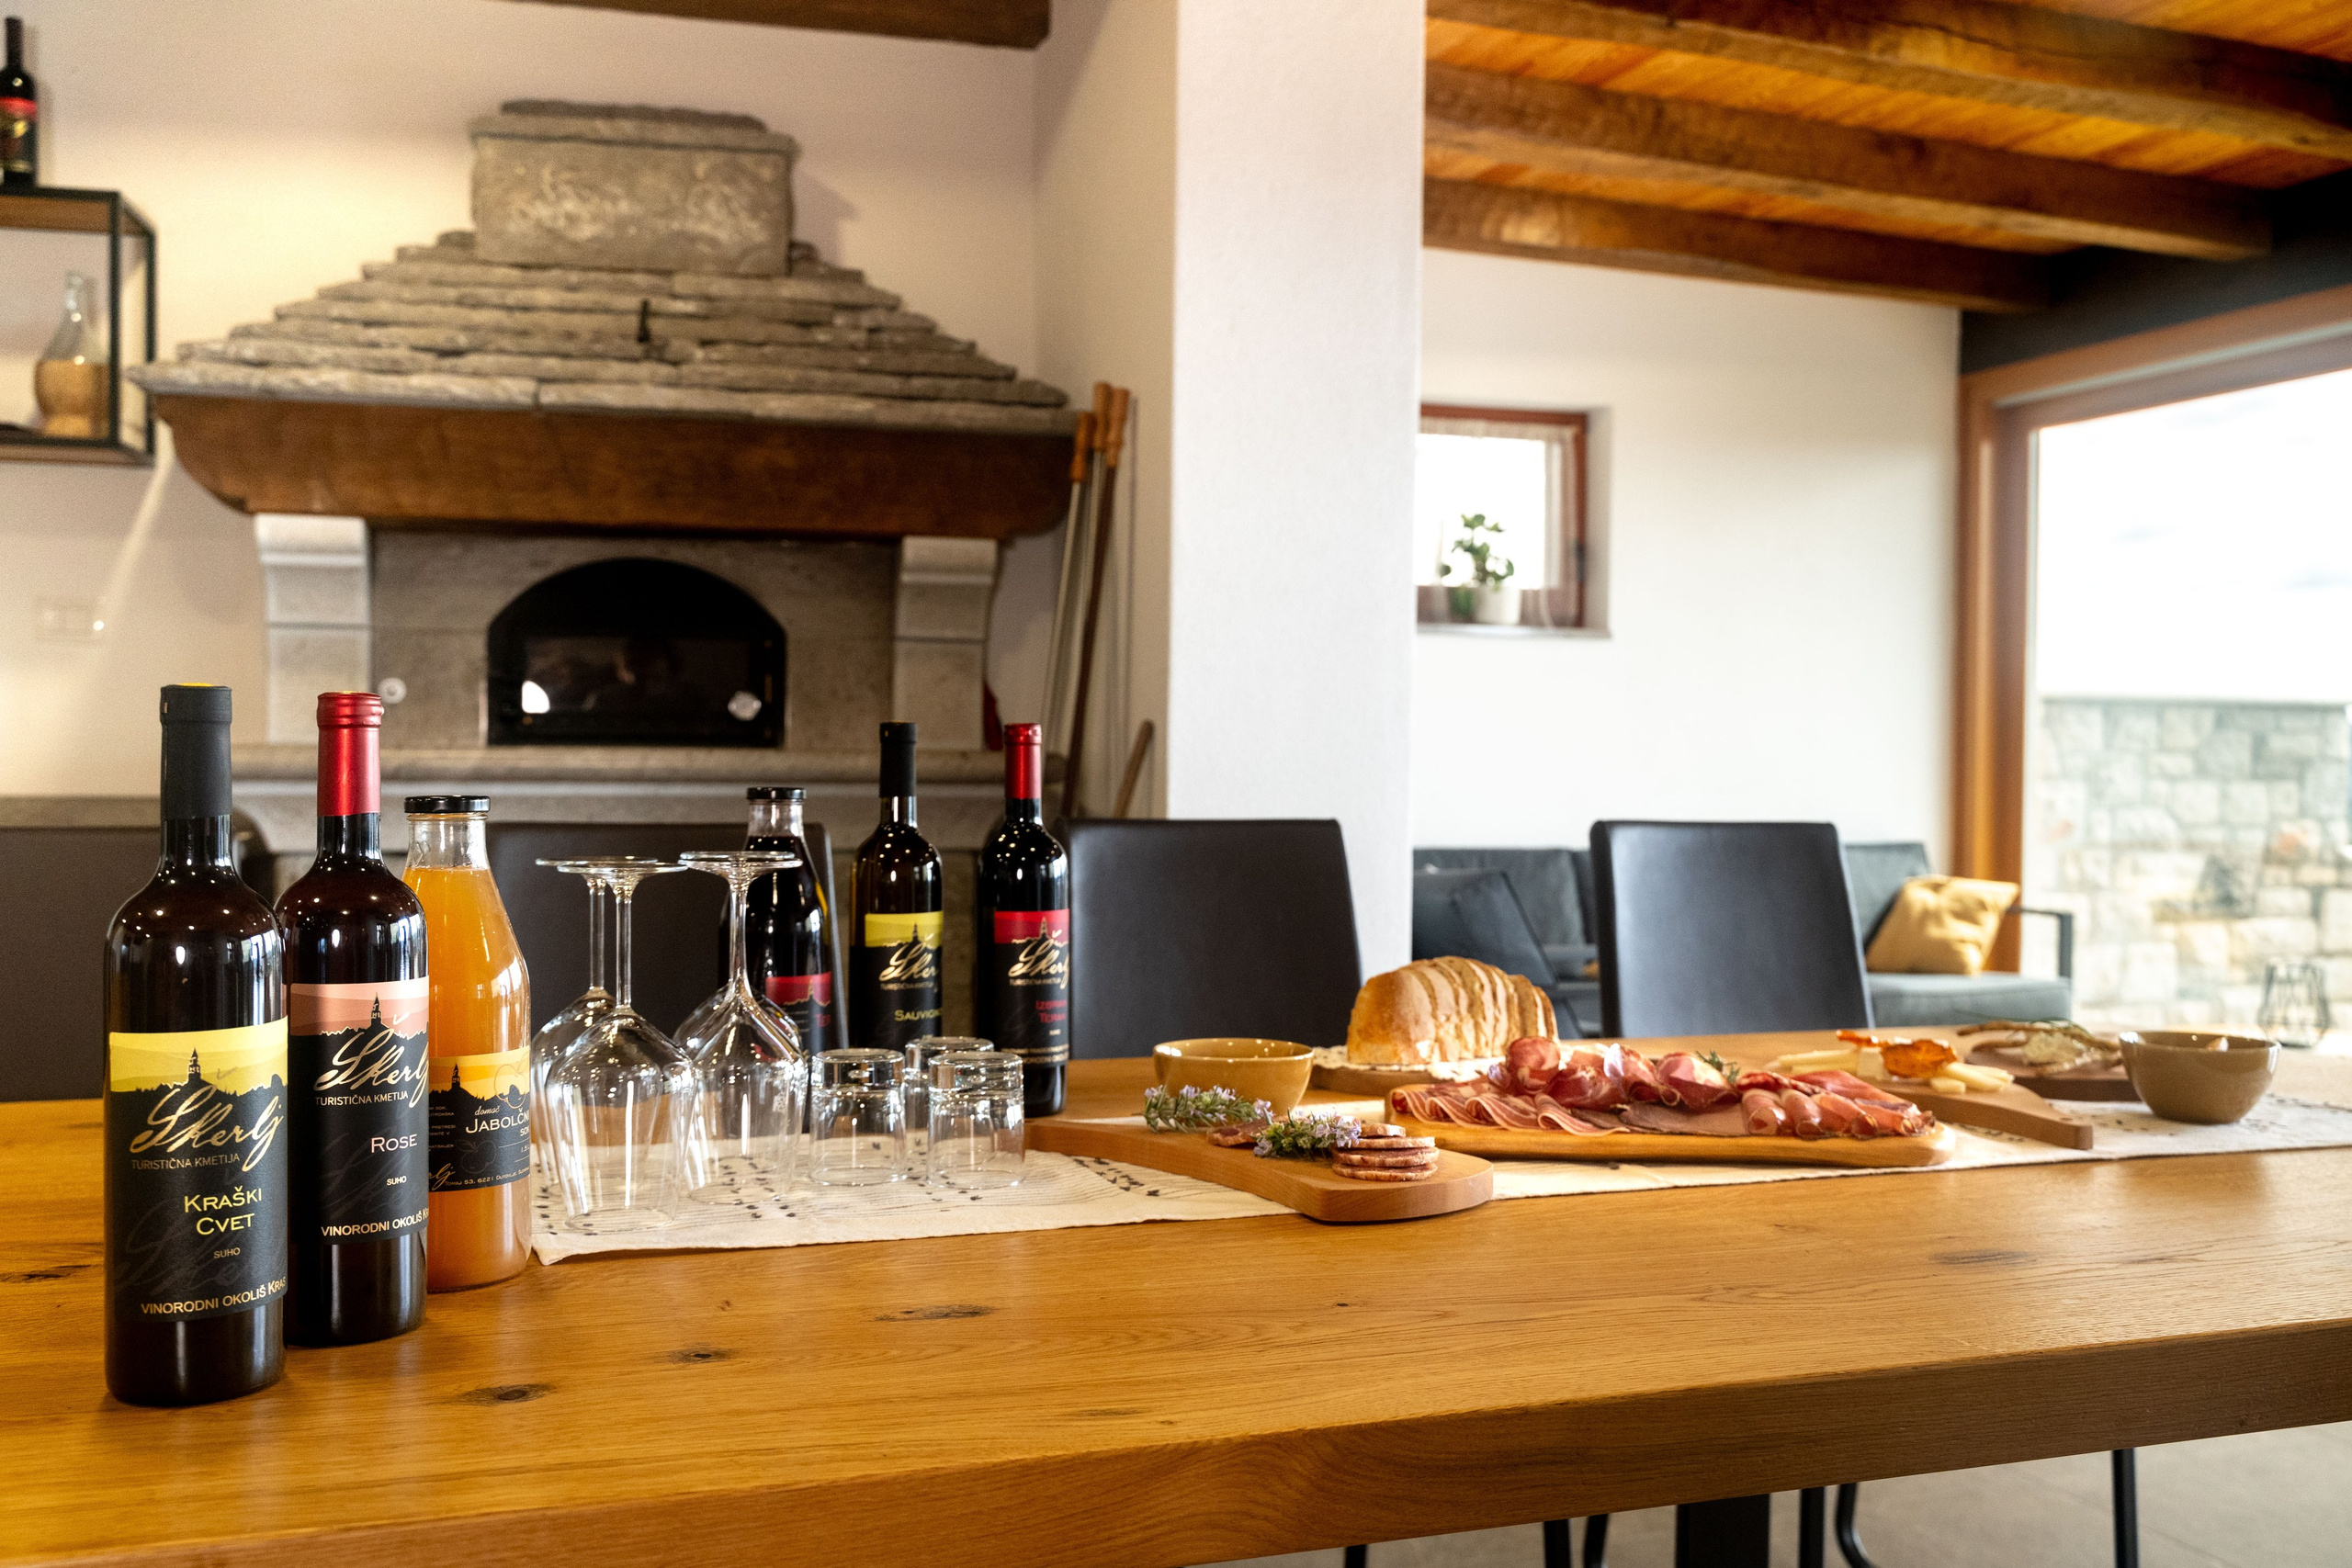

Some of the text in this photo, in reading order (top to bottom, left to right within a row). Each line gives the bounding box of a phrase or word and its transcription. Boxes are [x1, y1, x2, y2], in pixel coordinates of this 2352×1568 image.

[315, 1090, 409, 1106] TURISTIČNA KMETIJA
[371, 1134, 418, 1154] ROSE
[131, 1153, 241, 1170] TURISTIČNA KMETIJA
[386, 1176, 408, 1186] SUHO
[184, 1185, 263, 1213] KRAŠKI
[196, 1213, 255, 1235] CVET
[322, 1221, 390, 1237] VINORODNI
[391, 1210, 423, 1229] OKOLIŠ
[213, 1247, 241, 1259] SUHO
[141, 1297, 219, 1314] VINORODNI
[222, 1284, 266, 1307] OKOLIŠ
